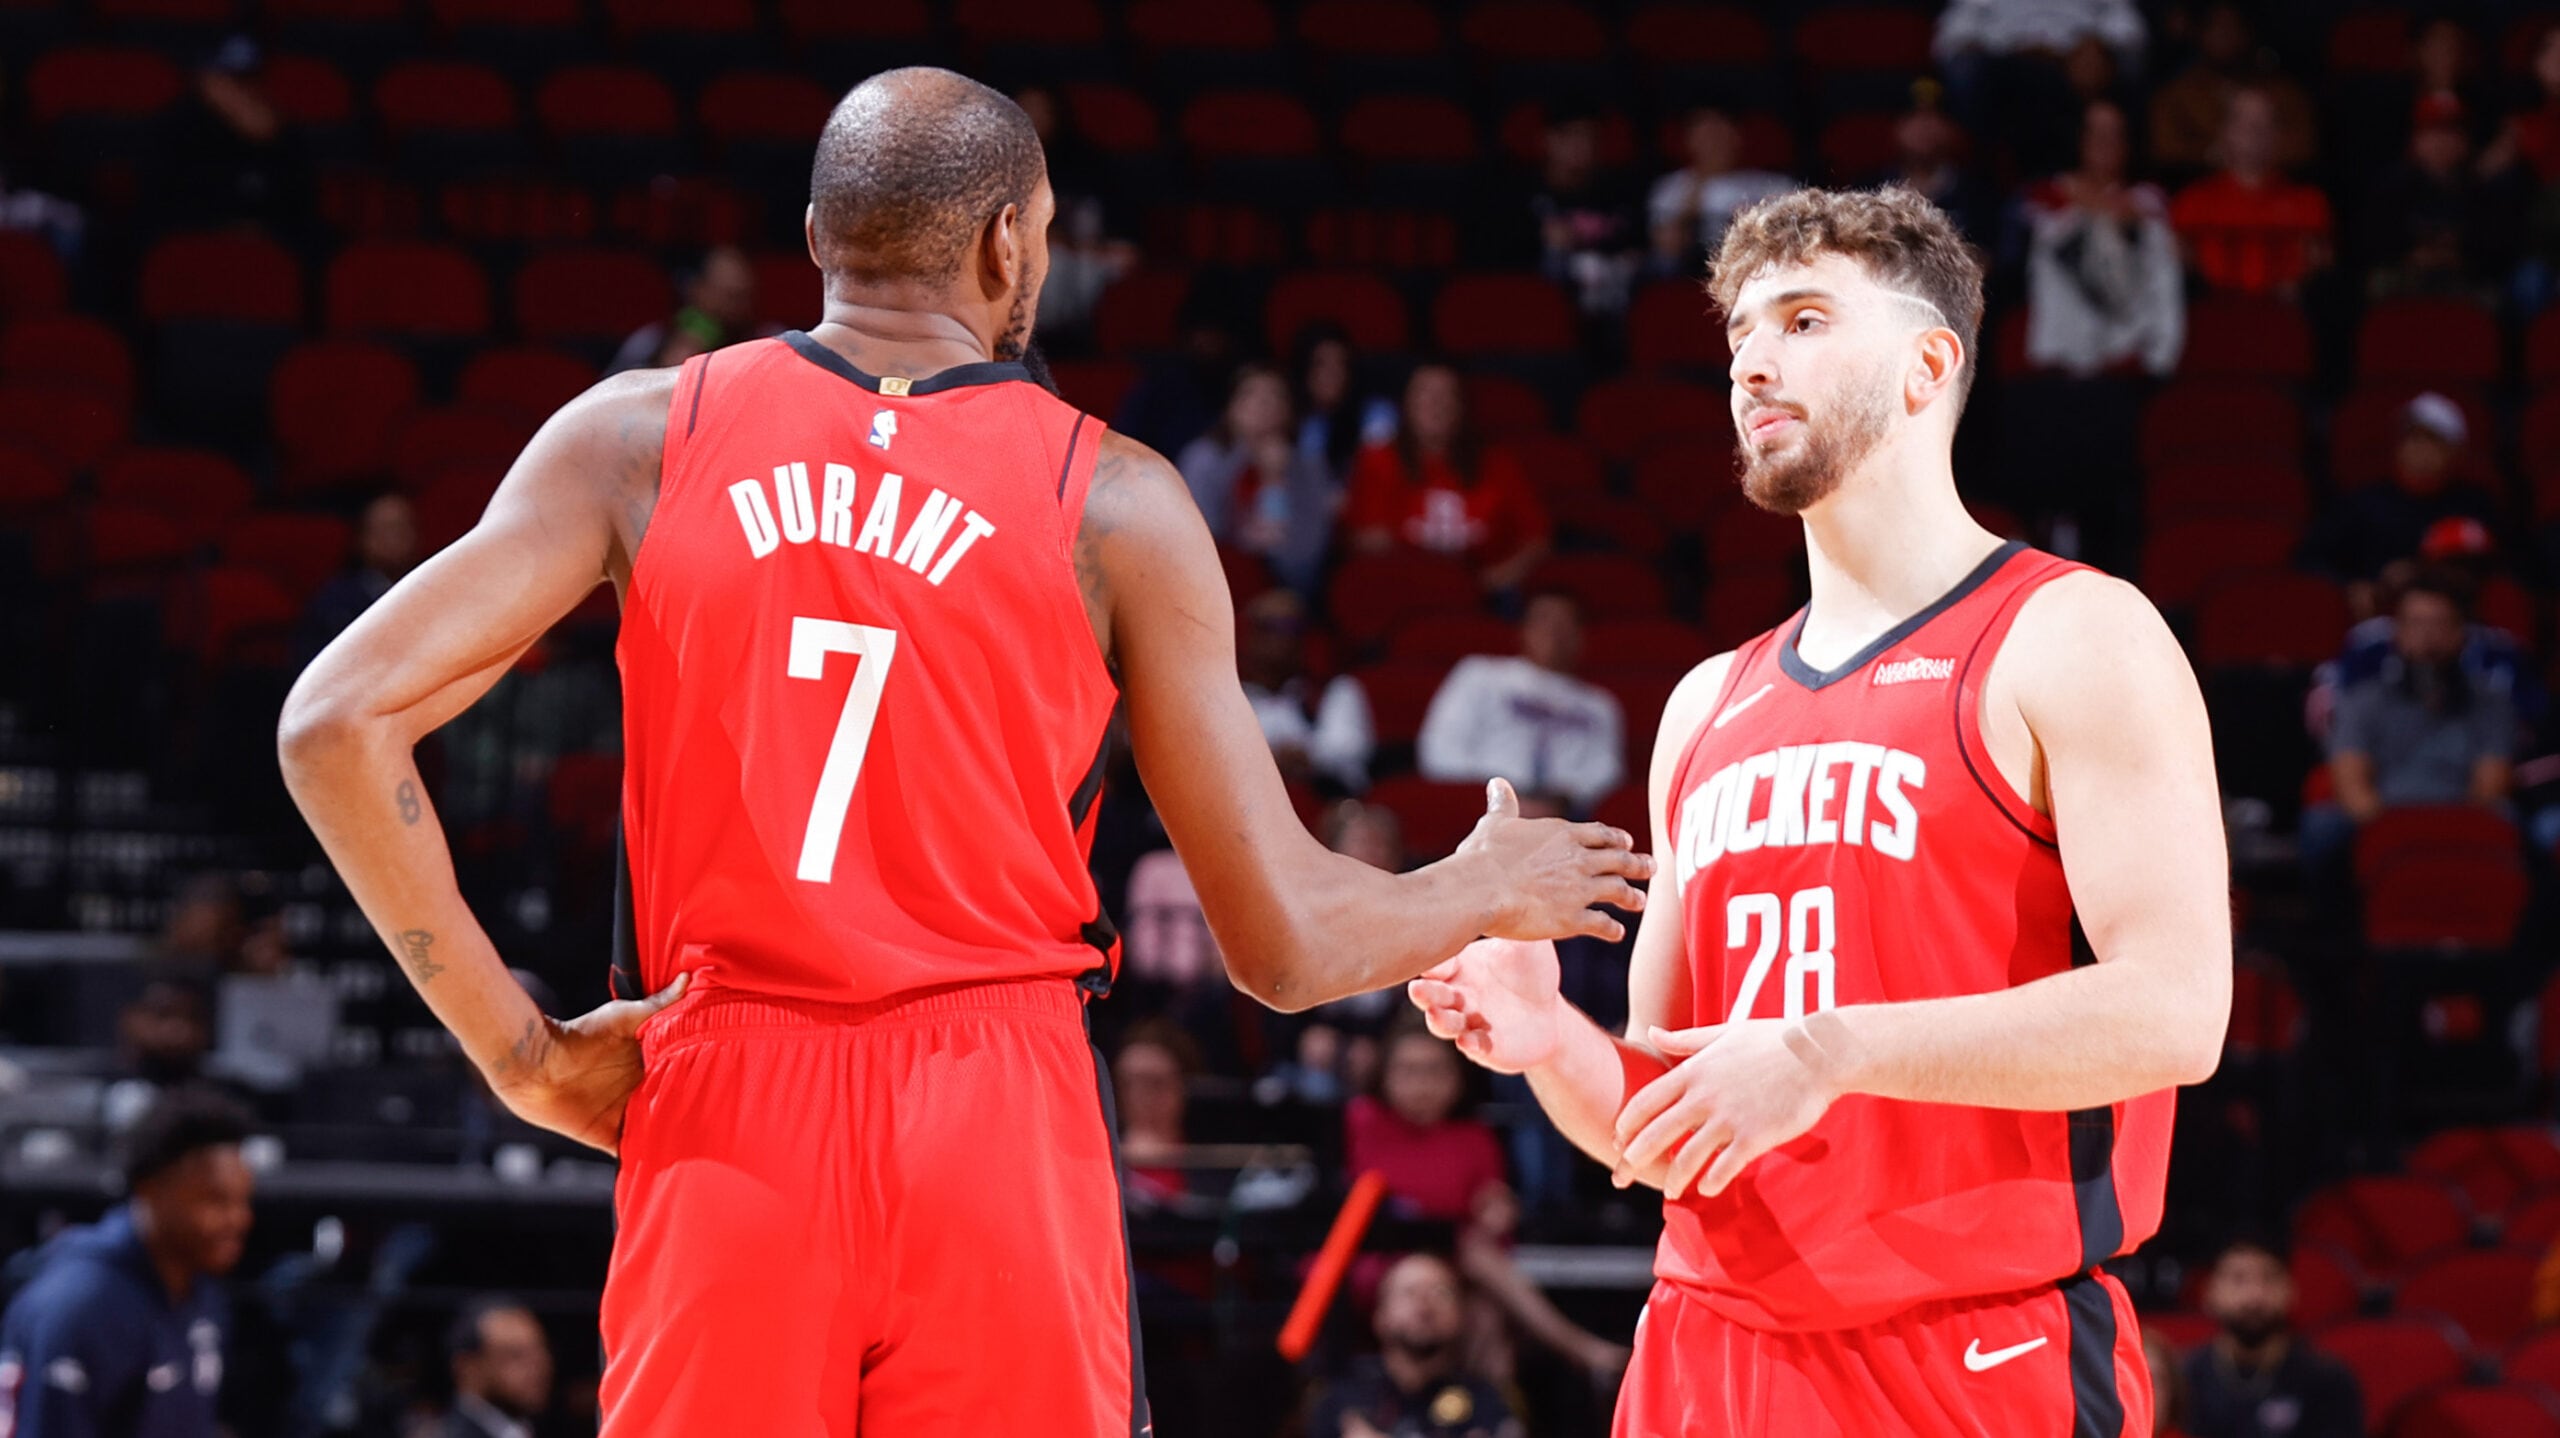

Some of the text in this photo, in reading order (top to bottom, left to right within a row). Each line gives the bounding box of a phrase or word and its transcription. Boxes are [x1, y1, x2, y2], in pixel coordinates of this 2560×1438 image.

[728, 461, 996, 586] DURANT
[787, 616, 898, 884] 7
[1675, 740, 1926, 898] ROCKETS
[1726, 885, 1836, 1024] 28
